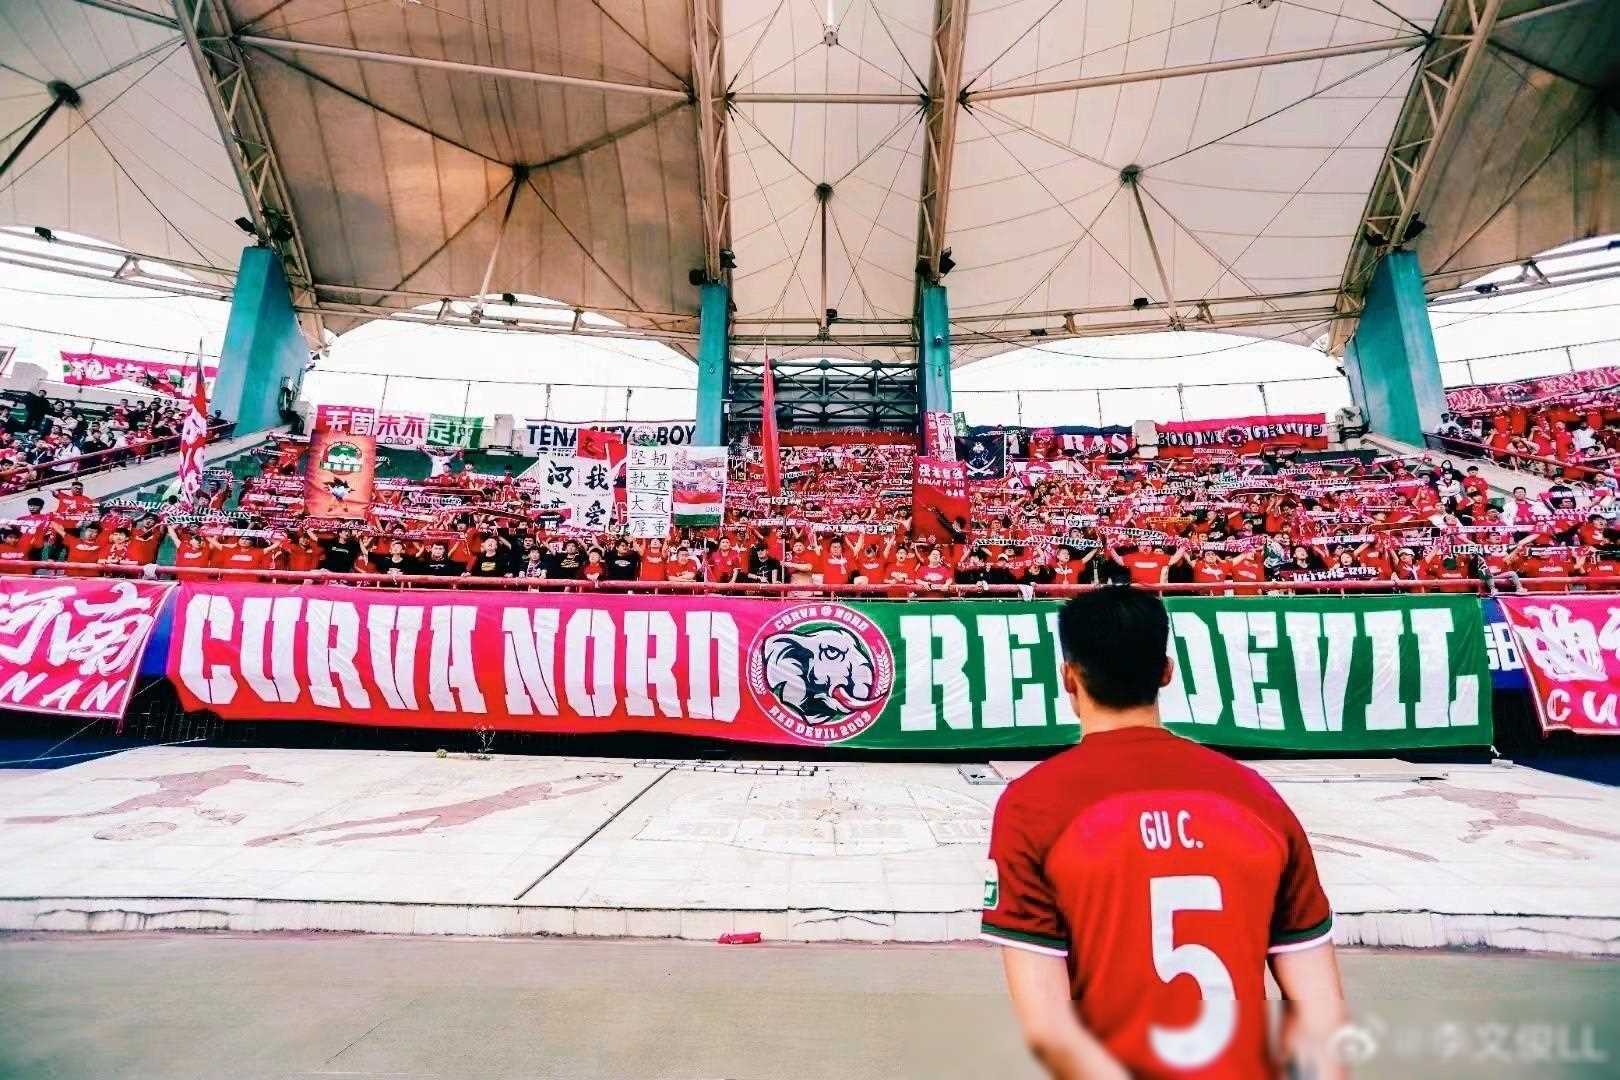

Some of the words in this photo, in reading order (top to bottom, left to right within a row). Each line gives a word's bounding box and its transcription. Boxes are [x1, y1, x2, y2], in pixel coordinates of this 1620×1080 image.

[180, 593, 487, 713] CURVA
[502, 607, 741, 722] NORD
[1159, 608, 1479, 731] DEVIL
[795, 723, 839, 739] DEVIL
[1139, 810, 1172, 849] GU
[1177, 810, 1204, 849] C.
[1150, 875, 1237, 1068] 5
